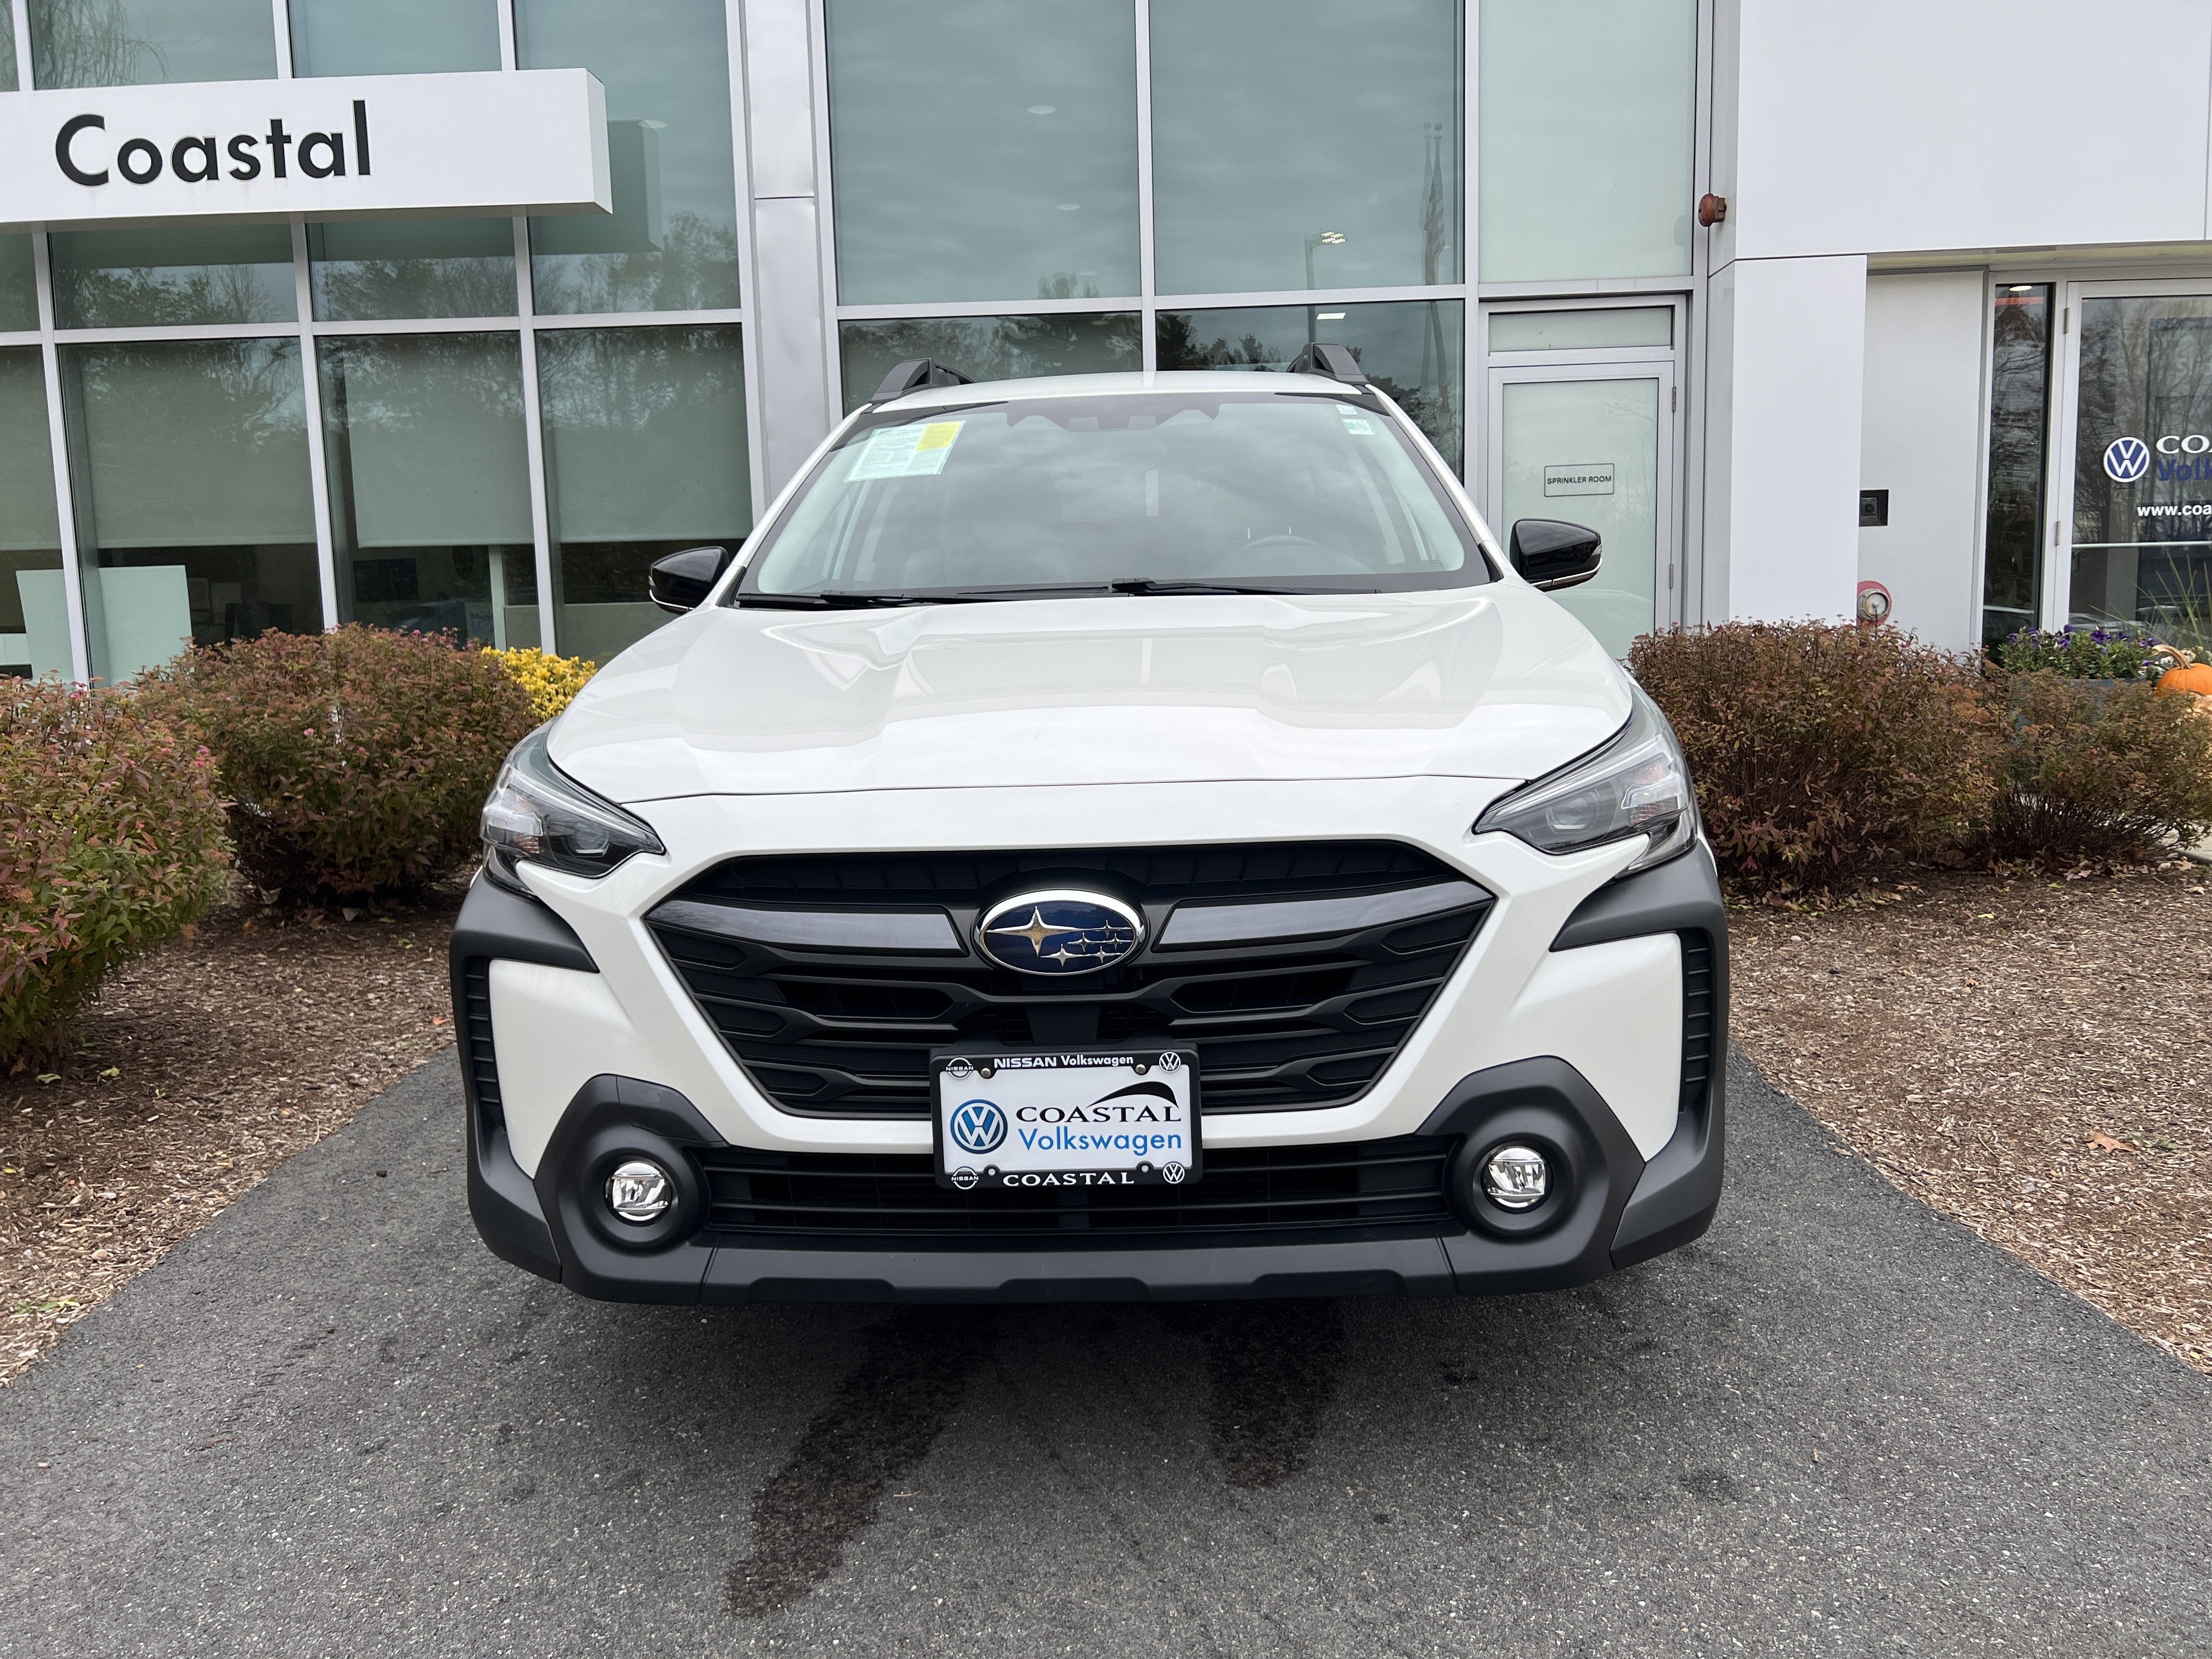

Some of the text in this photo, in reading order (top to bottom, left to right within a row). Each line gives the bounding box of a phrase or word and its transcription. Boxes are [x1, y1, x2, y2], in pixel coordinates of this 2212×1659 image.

[55, 100, 370, 186] Coastal
[2156, 435, 2212, 454] CO
[994, 1054, 1133, 1069] NISSAN Volkswagen
[1016, 1105, 1181, 1122] COASTAL
[1018, 1126, 1182, 1156] Volkswagen
[1003, 1171, 1135, 1186] COASTAL
